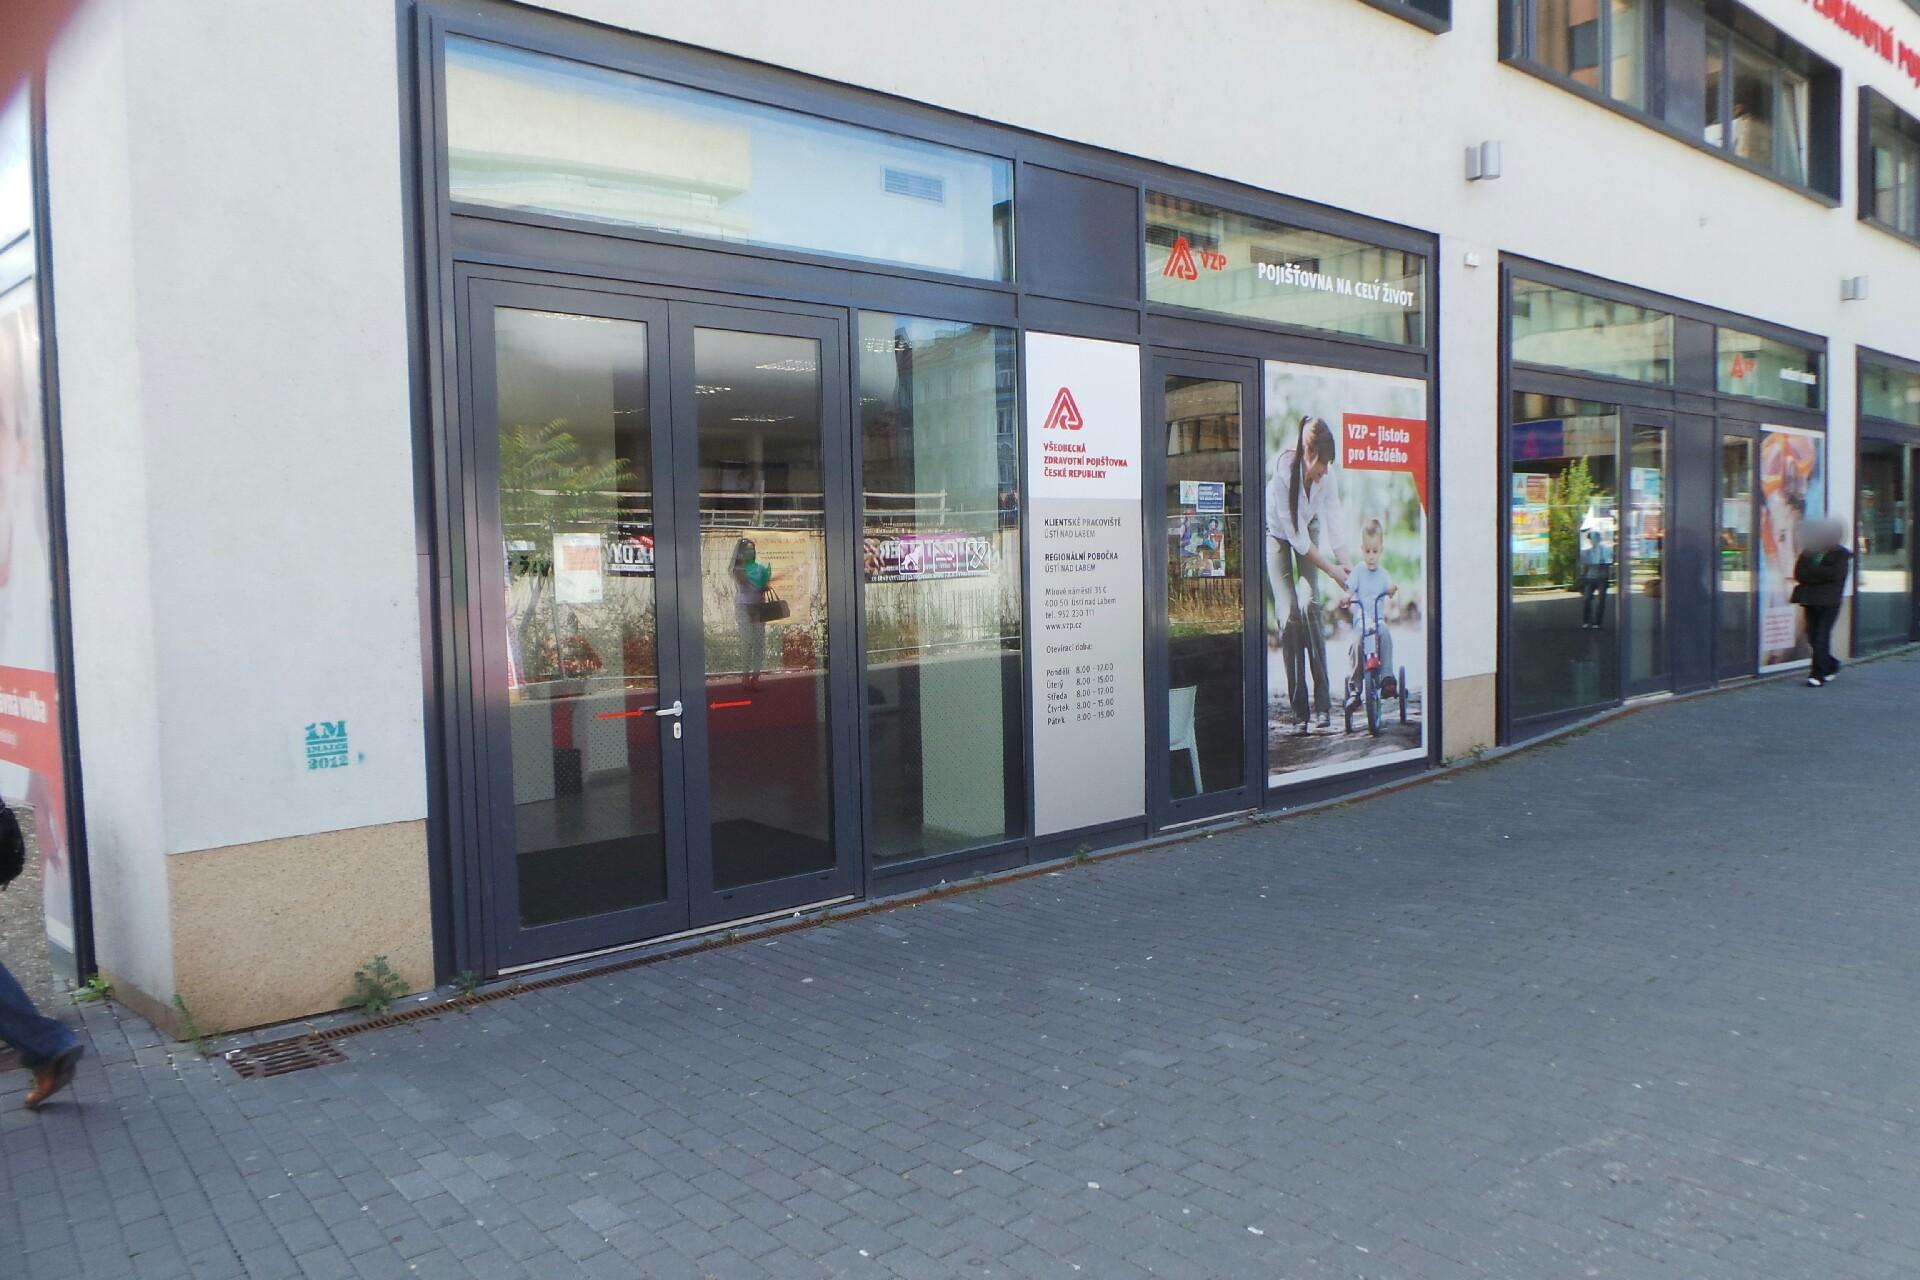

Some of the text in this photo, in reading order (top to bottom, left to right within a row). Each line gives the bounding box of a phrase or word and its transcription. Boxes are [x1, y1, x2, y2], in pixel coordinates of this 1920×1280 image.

[1199, 250, 1414, 307] VZP POJIŠŤOVNA NA CELÝ ŽIVOT
[1347, 423, 1368, 439] VZP
[1377, 425, 1410, 445] jistota
[1043, 441, 1086, 453] VŠEOBECNÁ
[1347, 446, 1408, 464] pro každého
[1043, 455, 1128, 468] ZDRAVOTNÍ POJIŠŤOVNA
[1044, 467, 1106, 479] ČESKÉ REPUBLIKY
[1044, 517, 1081, 527] KLIENTSKÉ
[1060, 530, 1074, 538] NAD
[1074, 530, 1095, 538] LABEM
[1044, 550, 1118, 561] REGIONÁLNÍ POBOČKA
[1061, 565, 1074, 573] NAD
[1075, 564, 1096, 572] LABEM
